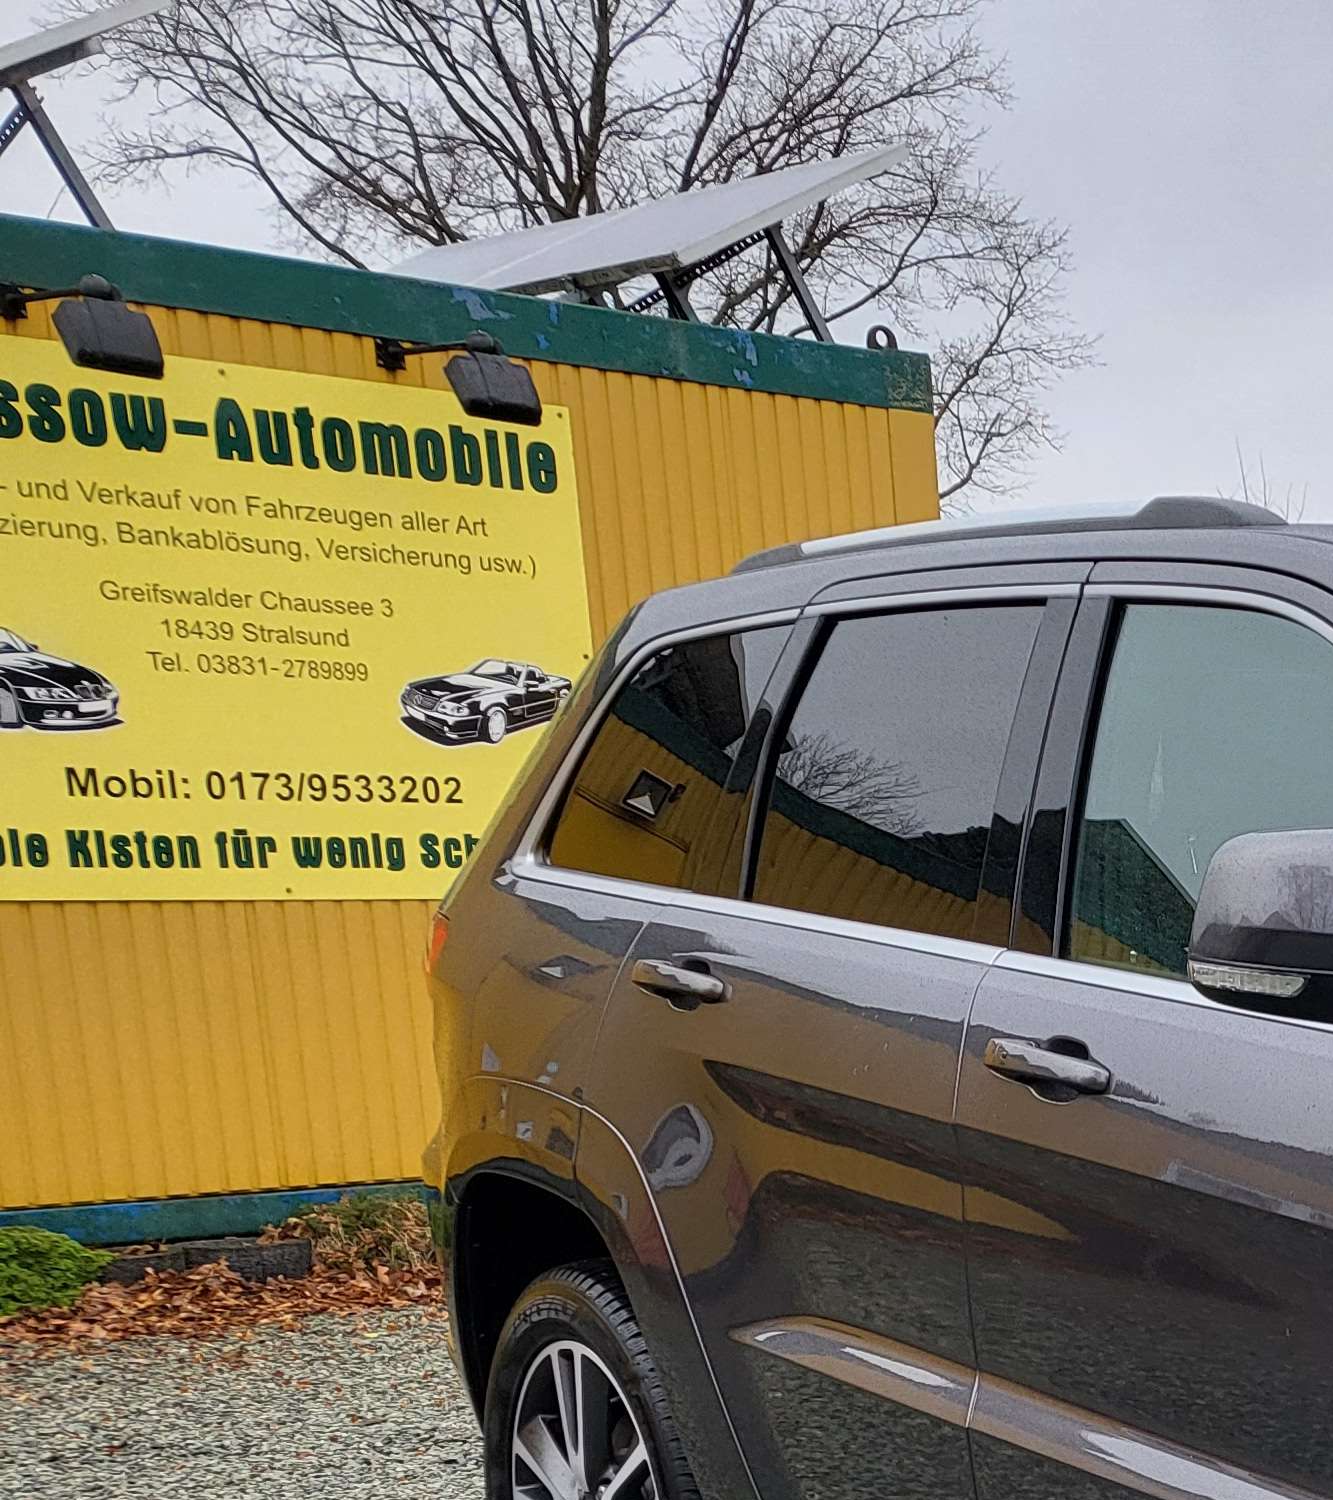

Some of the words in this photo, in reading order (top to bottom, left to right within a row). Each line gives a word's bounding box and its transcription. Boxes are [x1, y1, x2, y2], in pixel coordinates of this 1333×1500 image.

[17, 478, 69, 501] und
[76, 480, 182, 509] Verkauf
[189, 496, 237, 515] von
[246, 495, 393, 531] Fahrzeugen
[402, 511, 451, 535] aller
[455, 515, 488, 538] Art
[117, 521, 310, 562] Bankablösung,
[317, 538, 472, 576] Versicherung
[479, 553, 537, 579] usw.)
[99, 580, 251, 610] Greifswalder
[260, 590, 374, 617] Chaussee
[381, 598, 394, 617] 3
[161, 619, 234, 641] 18439
[242, 622, 350, 648] Stralsund
[146, 651, 190, 673] Tel.
[196, 654, 369, 682] 03831-2789899
[65, 767, 191, 800] Mobil:
[205, 771, 464, 804] 0173/9533202
[0, 828, 49, 868] le
[65, 829, 201, 868] Kisten
[215, 829, 277, 868] für
[291, 833, 405, 871] wenig
